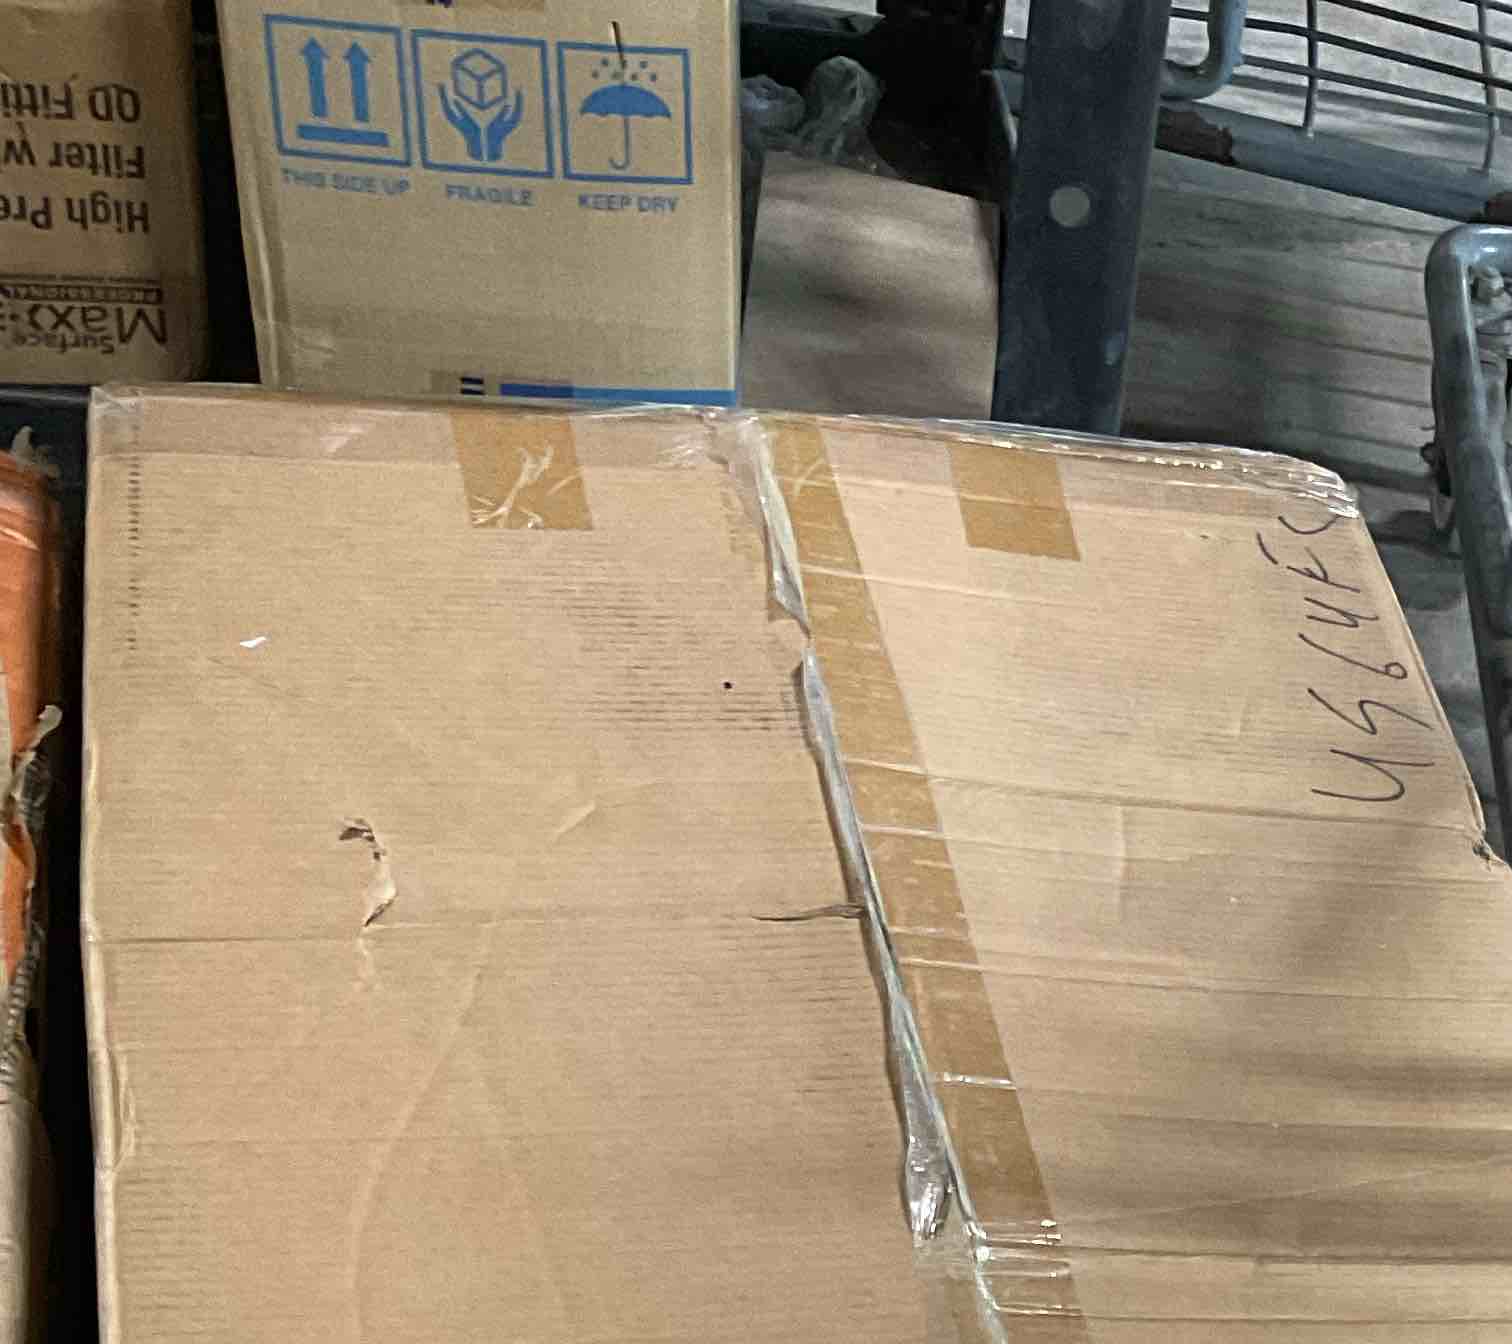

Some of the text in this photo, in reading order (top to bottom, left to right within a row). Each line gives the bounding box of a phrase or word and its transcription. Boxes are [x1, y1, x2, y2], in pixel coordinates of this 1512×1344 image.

[87, 83, 141, 123] QD
[49, 144, 146, 179] Filter
[281, 168, 410, 196] THIS SIDE UP
[445, 183, 536, 208] FRAGILE
[64, 190, 150, 233] High
[577, 193, 681, 214] KEEP DRY
[15, 331, 115, 354] Surface
